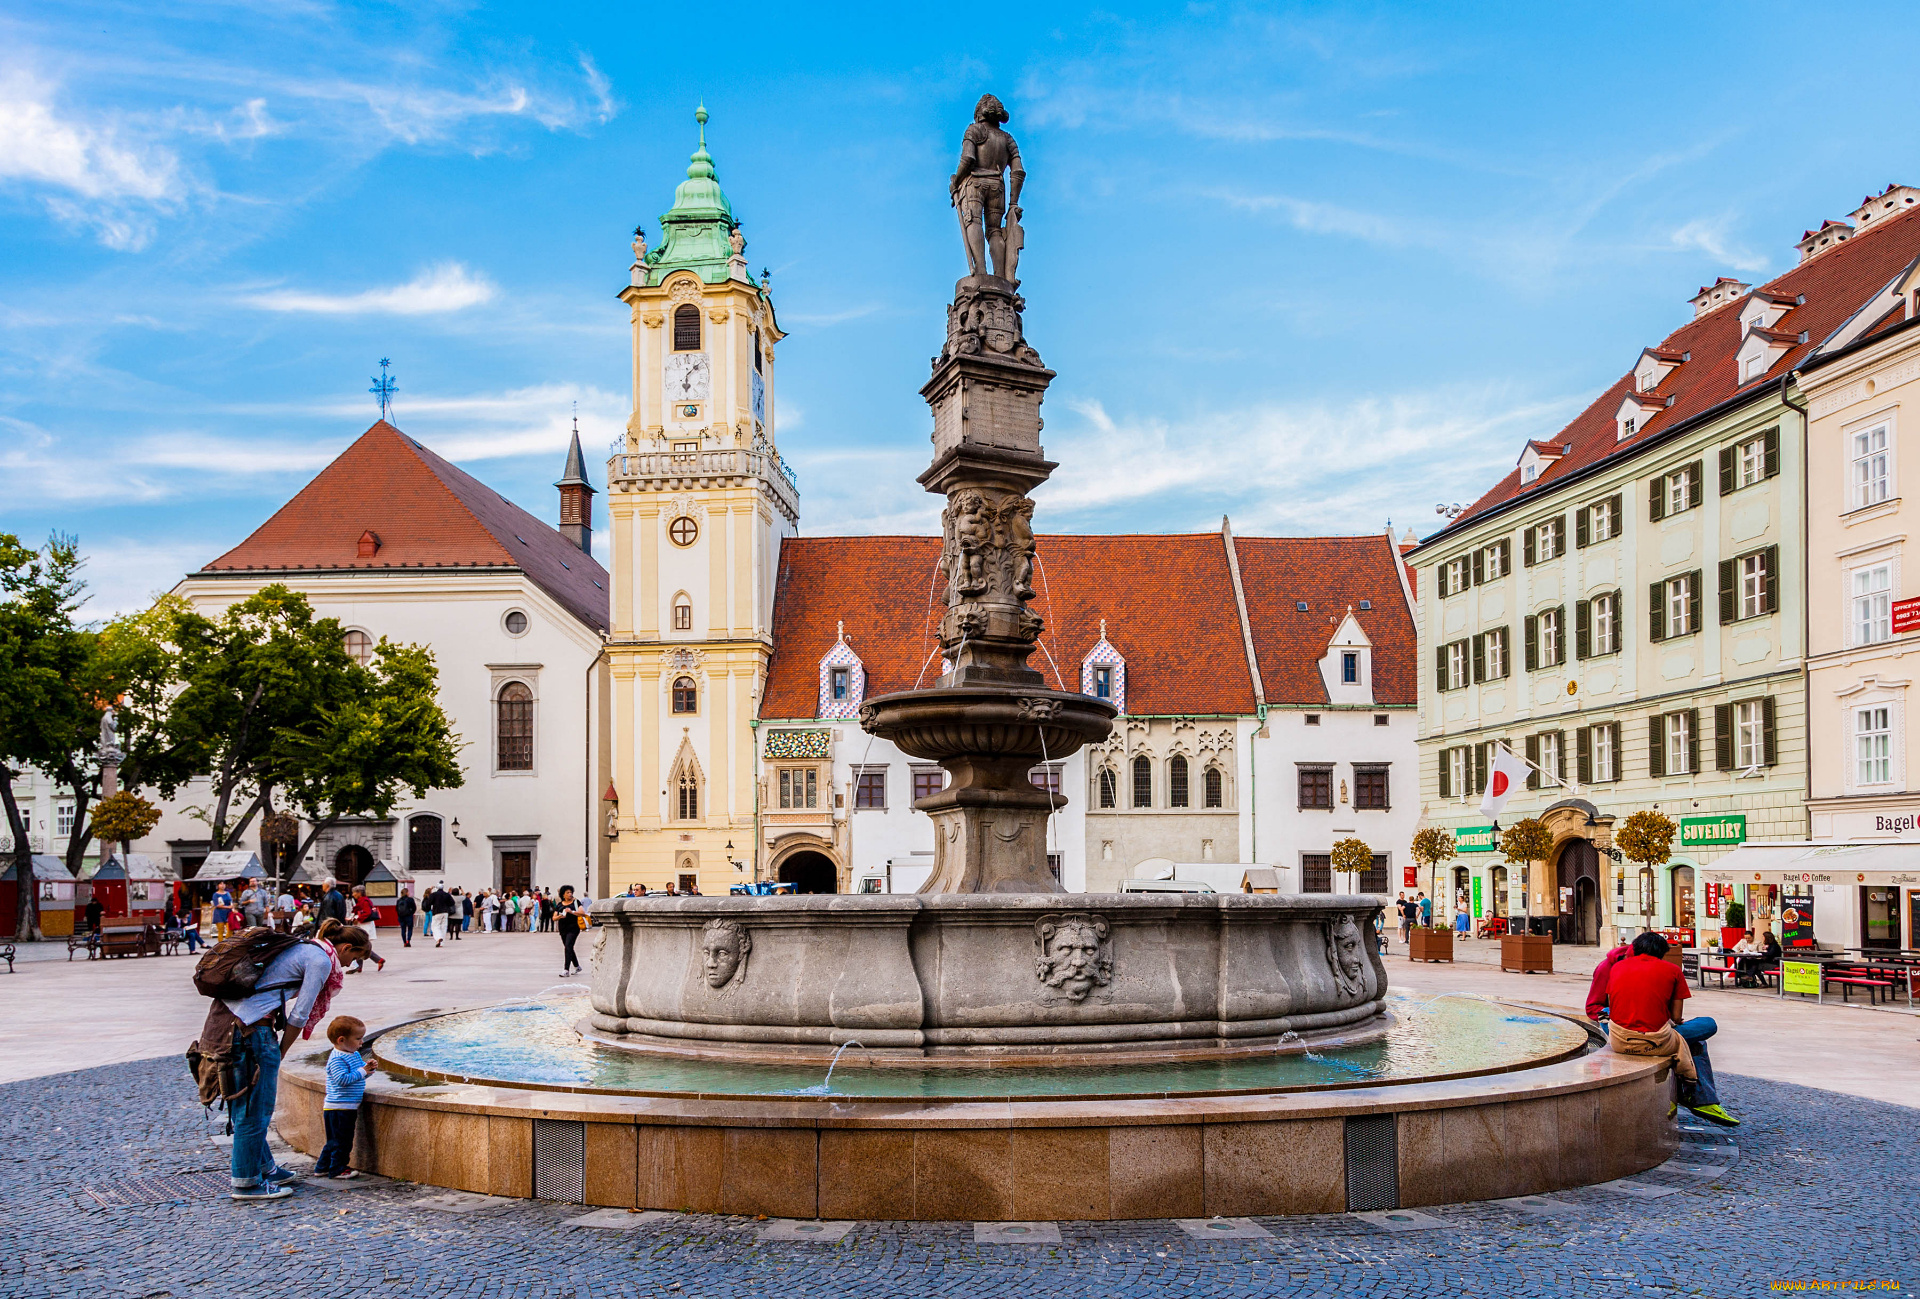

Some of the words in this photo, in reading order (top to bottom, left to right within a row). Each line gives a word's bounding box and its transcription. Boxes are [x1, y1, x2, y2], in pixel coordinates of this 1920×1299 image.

[1683, 819, 1741, 840] SUVENÍRY
[1876, 815, 1914, 833] Bagel
[1783, 873, 1800, 882] Bagel
[1811, 873, 1831, 882] Coffee
